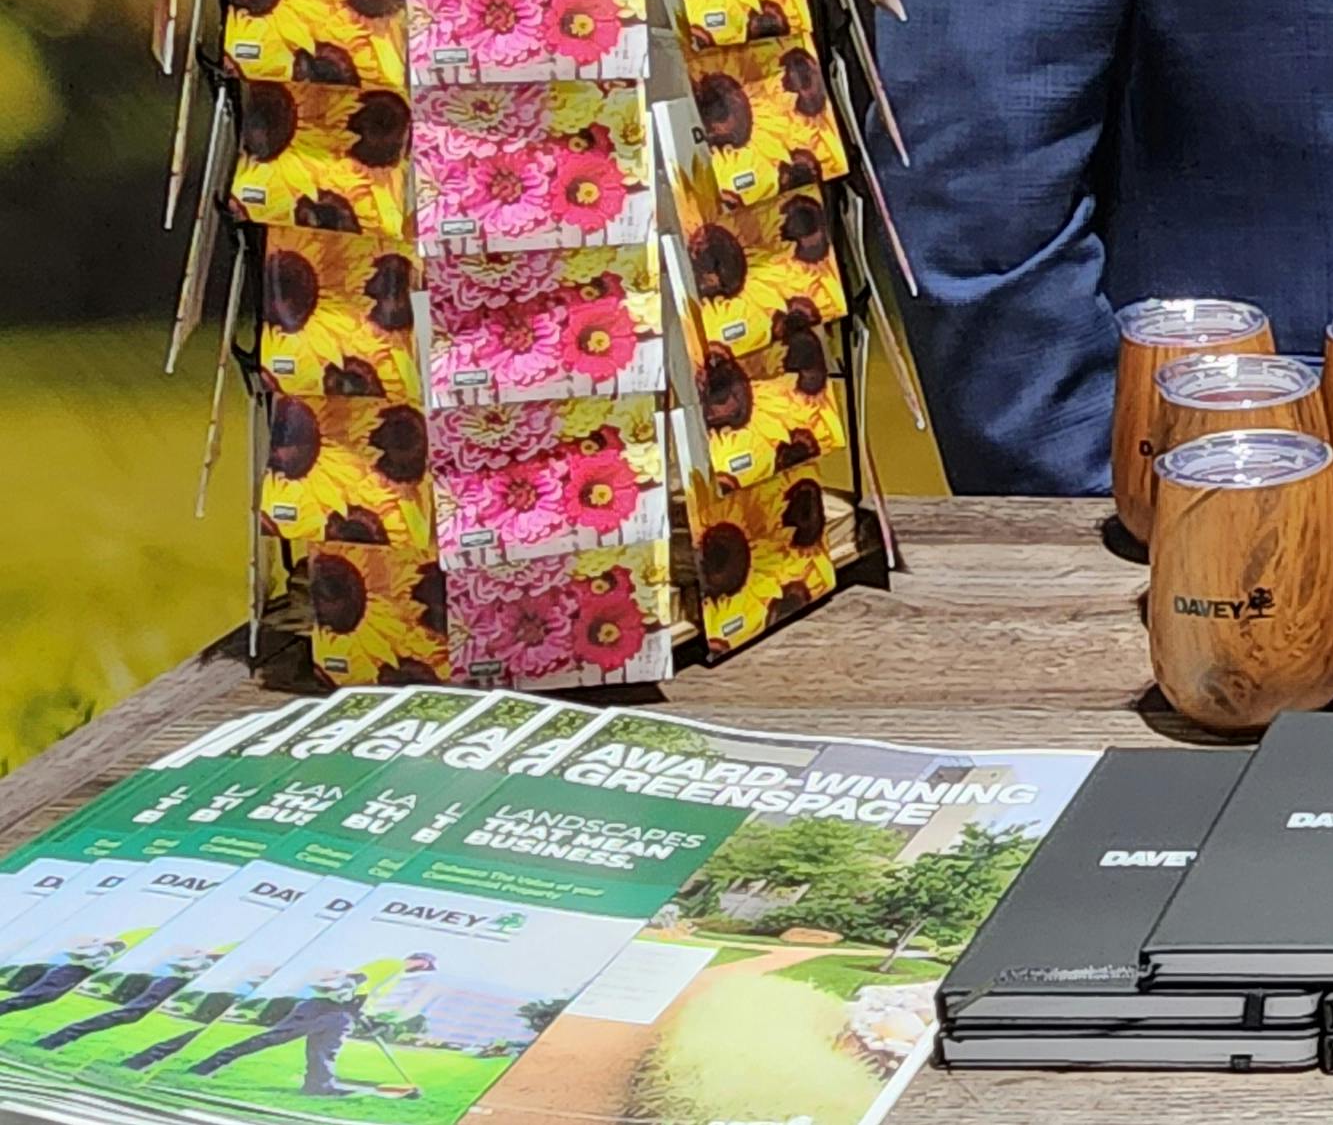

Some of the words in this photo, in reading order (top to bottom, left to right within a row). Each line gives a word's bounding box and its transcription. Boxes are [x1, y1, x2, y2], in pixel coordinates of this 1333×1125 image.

[1173, 595, 1246, 620] DAVEY
[563, 761, 945, 826] GREENSPACE
[577, 742, 1039, 806] AWARD-WINNING
[482, 817, 574, 843] THAT
[570, 832, 675, 860] MEAN
[496, 804, 706, 849] LANDSCAPES
[463, 828, 635, 870] BUSINESS.
[151, 873, 222, 892] DAV
[381, 900, 487, 929] DAVEY
